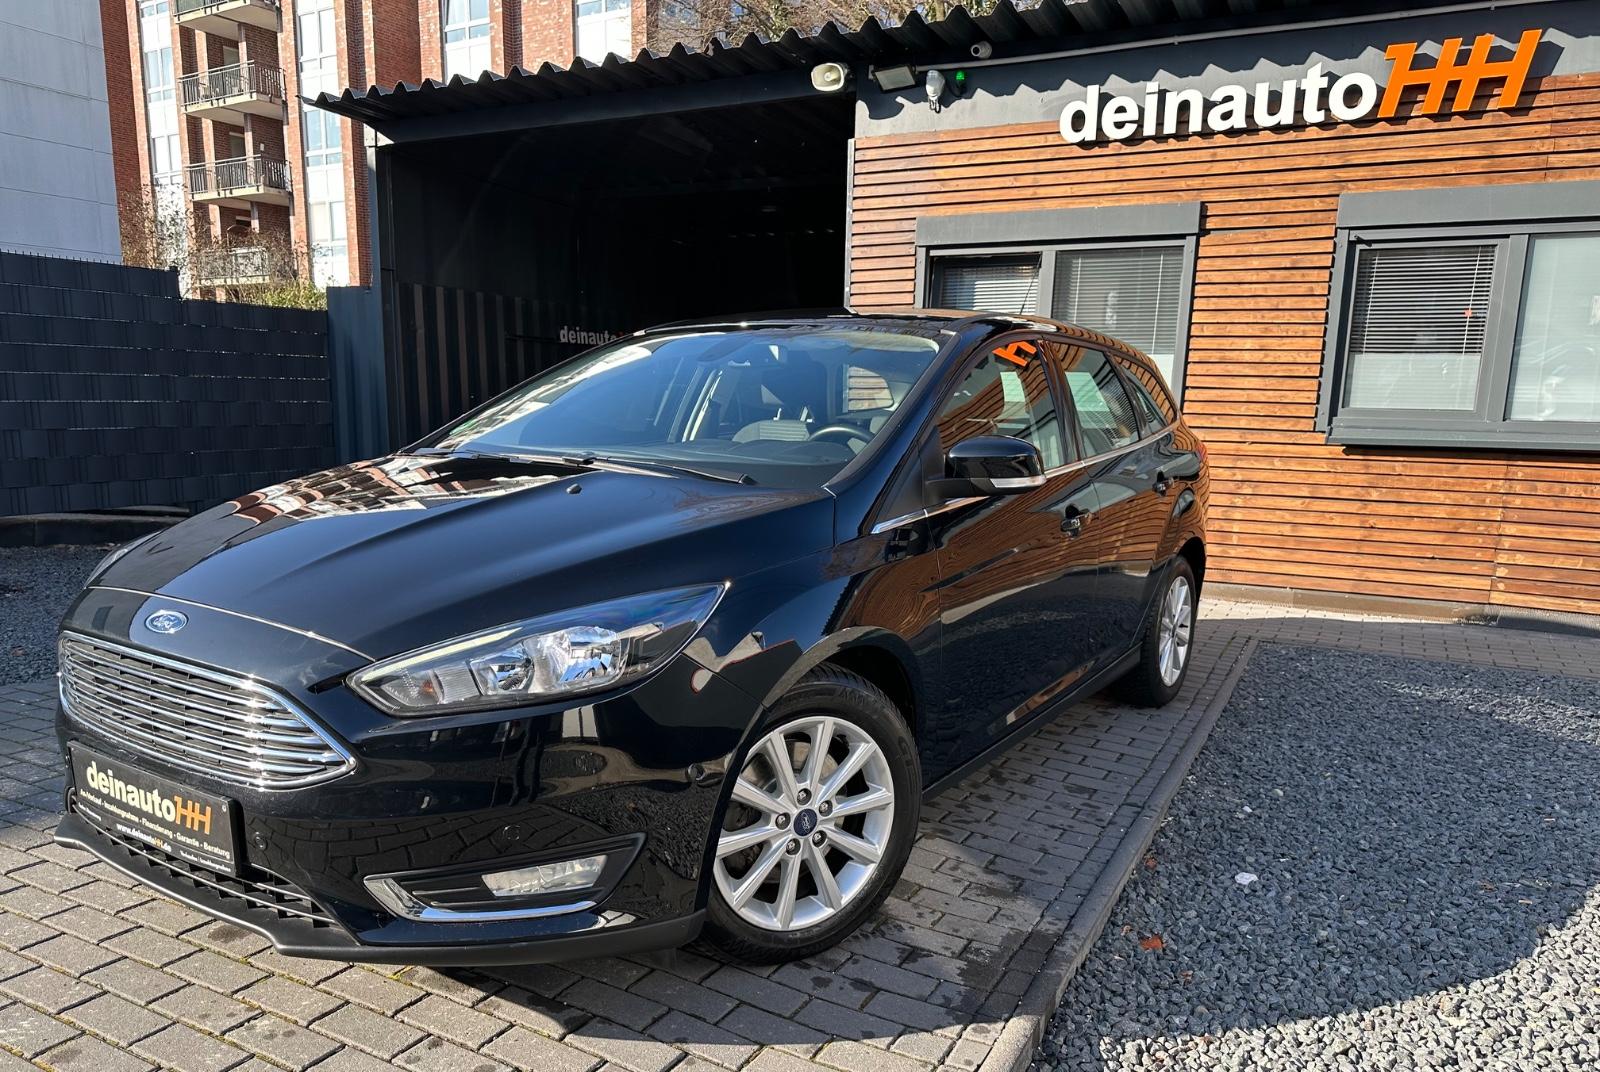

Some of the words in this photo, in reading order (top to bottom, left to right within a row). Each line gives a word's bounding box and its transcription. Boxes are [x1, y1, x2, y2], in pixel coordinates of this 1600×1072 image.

[1059, 29, 1542, 143] deinautoHH
[86, 760, 213, 835] deinautoHH
[176, 832, 200, 848] Garantie
[203, 841, 231, 860] Beratung
